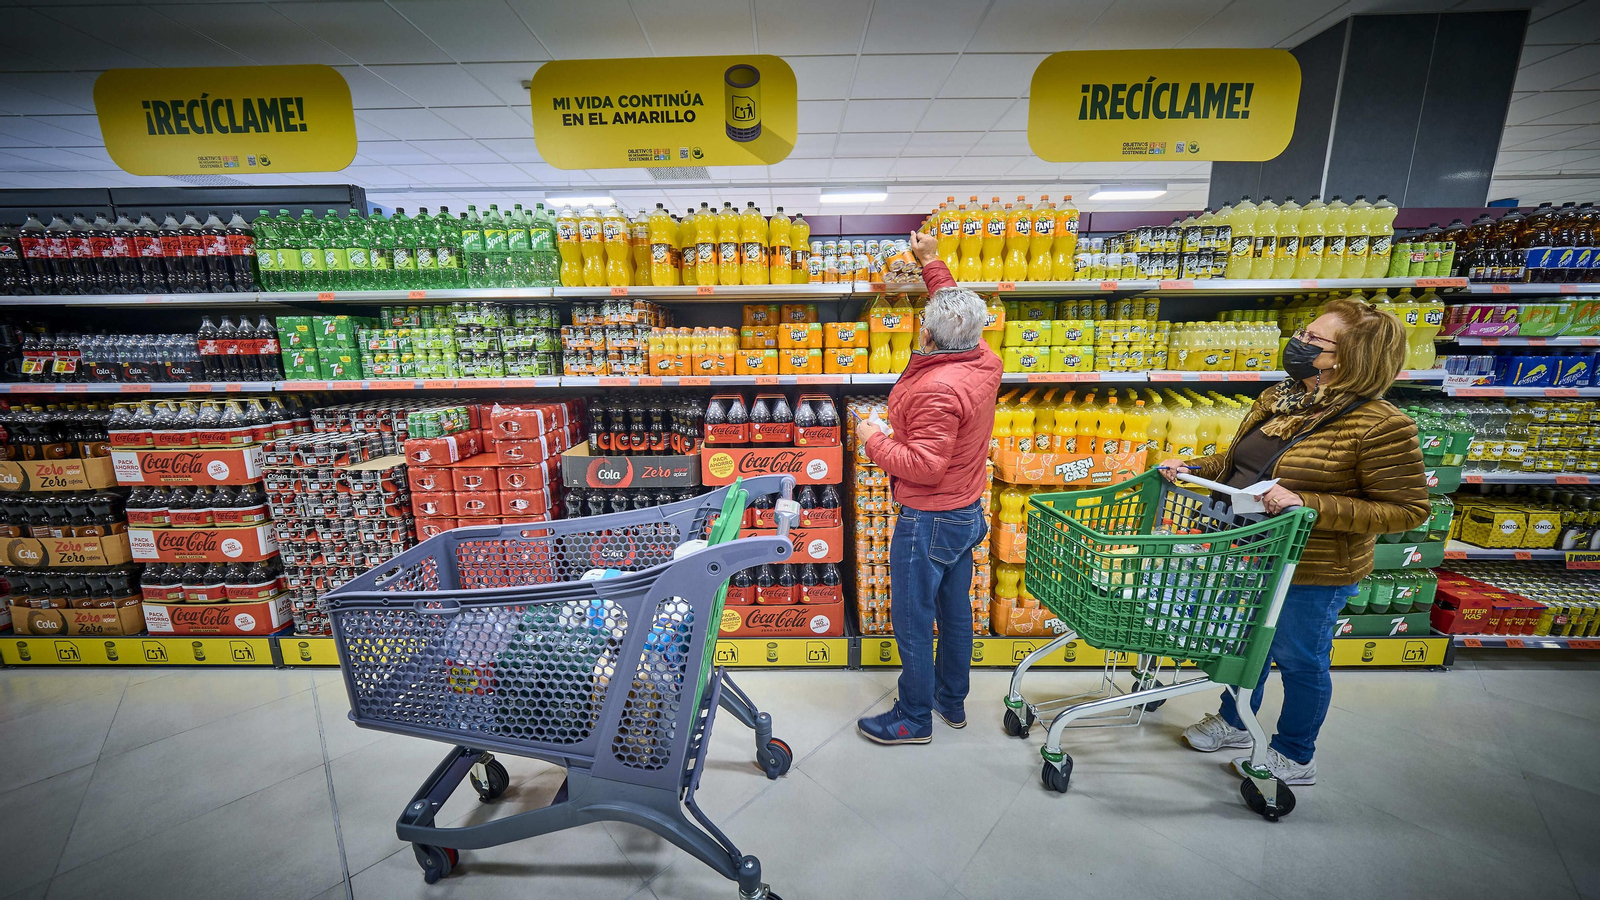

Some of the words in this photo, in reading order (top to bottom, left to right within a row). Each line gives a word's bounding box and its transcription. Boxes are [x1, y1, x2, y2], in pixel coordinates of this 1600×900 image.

[552, 97, 571, 110] MI
[574, 95, 614, 109] VIDA
[617, 90, 704, 108] CONTINÚA
[1078, 76, 1255, 120] ¡RECÍCLAME!
[142, 92, 308, 135] ¡RECÍCLAME!
[562, 113, 587, 126] EN
[588, 112, 610, 126] EL
[612, 109, 696, 125] AMARILLO
[710, 425, 741, 436] Coca-Cola
[758, 424, 788, 434] Coca-Cola
[802, 427, 834, 438] Coca-Cola
[115, 433, 140, 442] Coca-Cola
[159, 433, 185, 442] Coca-Cola
[141, 452, 205, 474] Coca-Cola
[709, 460, 733, 468] AHORRO
[738, 451, 807, 474] Coca-Cola
[1055, 456, 1095, 476] FRESH
[36, 462, 63, 476] Zero
[597, 469, 621, 480] Cola
[641, 465, 671, 479] Zero
[1063, 468, 1089, 483] GAS
[40, 476, 67, 488] Zero
[806, 510, 836, 520] Coca-Cola
[54, 541, 82, 552] Zero
[157, 531, 219, 551] Coca-Cola
[18, 549, 39, 559] Cola
[59, 552, 85, 563] Zero
[1402, 545, 1423, 567] 7up
[760, 588, 789, 598] Coca-Cola
[806, 588, 835, 597] Coca-Cola
[74, 612, 100, 623] Zero
[170, 607, 231, 626] Coca-Cola
[745, 608, 811, 629] Coca-Cola
[36, 620, 58, 629] Cola
[78, 623, 103, 634] Zero
[1389, 616, 1408, 636] 7up
